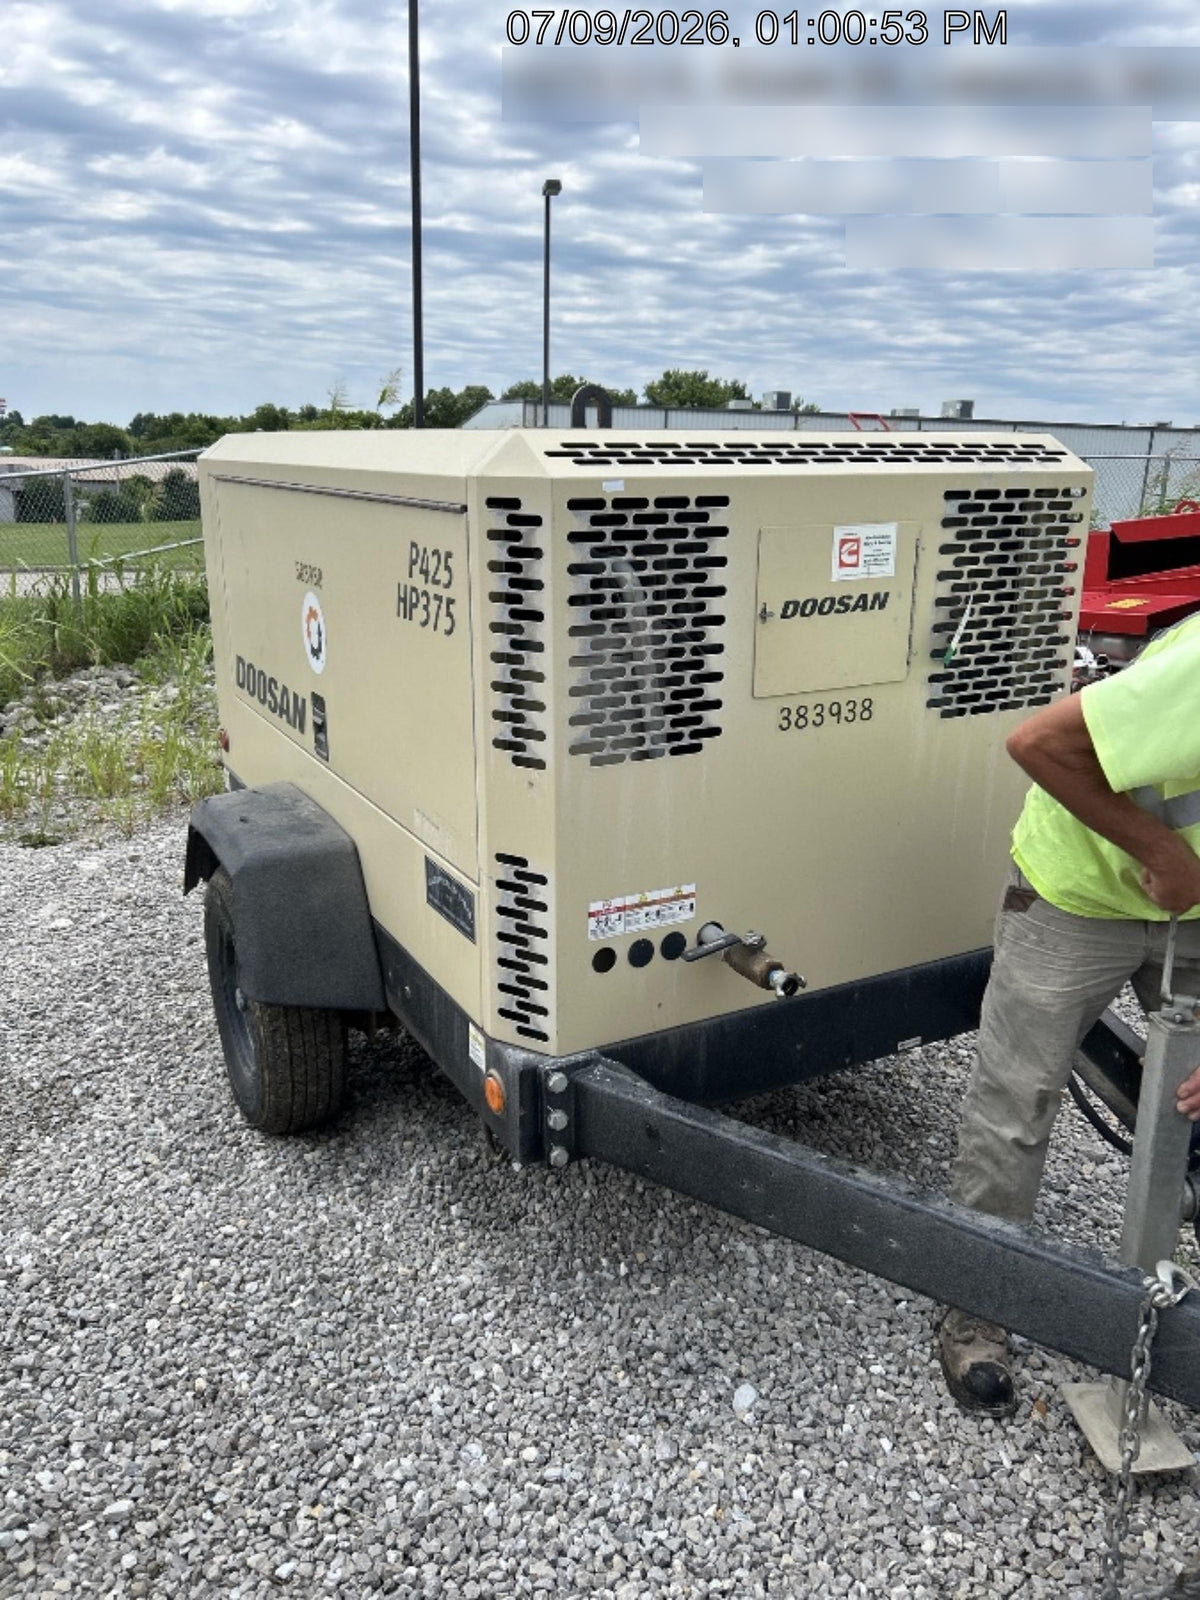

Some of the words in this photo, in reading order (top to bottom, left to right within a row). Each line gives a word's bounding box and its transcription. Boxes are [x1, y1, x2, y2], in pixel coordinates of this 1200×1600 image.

[408, 541, 453, 589] P425
[397, 582, 456, 636] HP375
[779, 591, 890, 620] DOOSAN
[235, 655, 306, 735] DOOSAN
[778, 697, 874, 732] 383938
